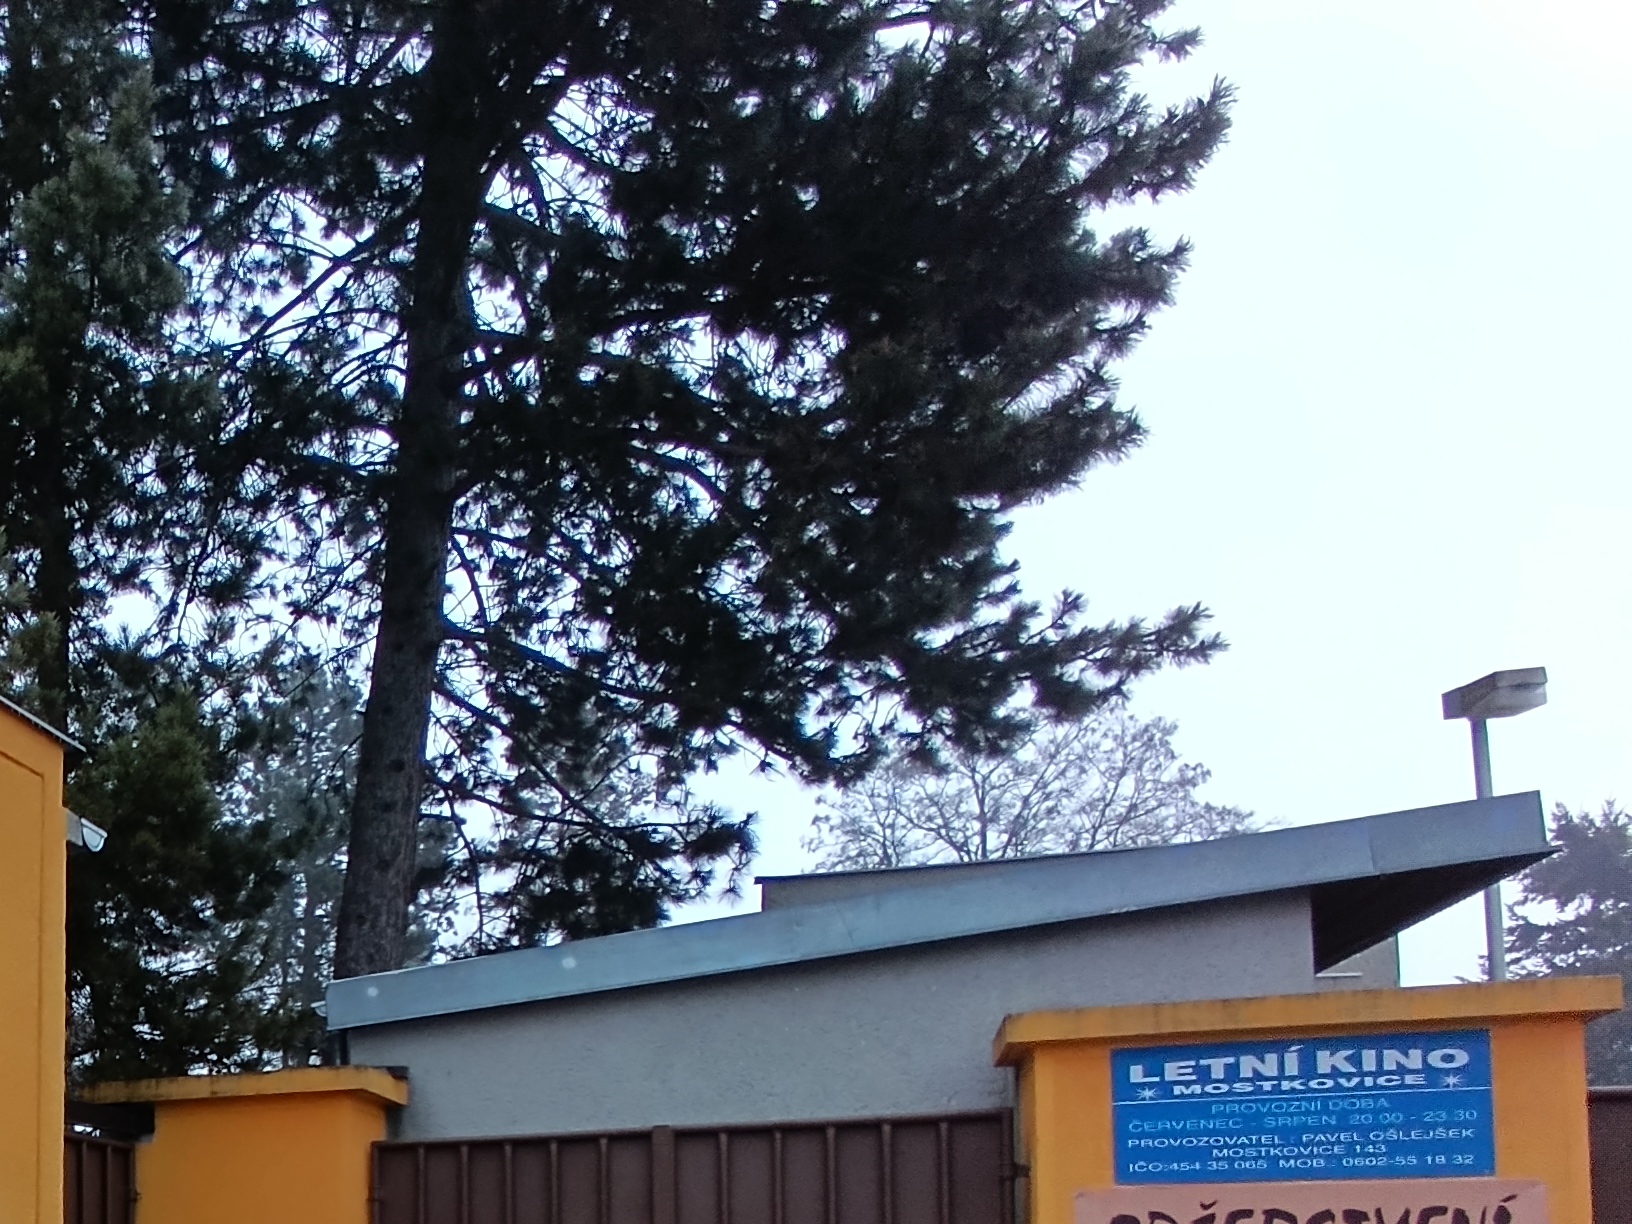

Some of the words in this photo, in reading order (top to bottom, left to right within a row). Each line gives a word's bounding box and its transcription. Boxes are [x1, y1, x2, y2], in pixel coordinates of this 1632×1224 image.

[1129, 1045, 1304, 1083] LETNÍ
[1317, 1048, 1470, 1075] KINO
[1172, 1073, 1426, 1096] MOSTKOVICE
[1211, 1098, 1321, 1115] PROVOZNÍ
[1329, 1097, 1391, 1111] DOBA
[1302, 1131, 1364, 1144] PAVEL
[1212, 1145, 1347, 1159] MOSTKOVICE
